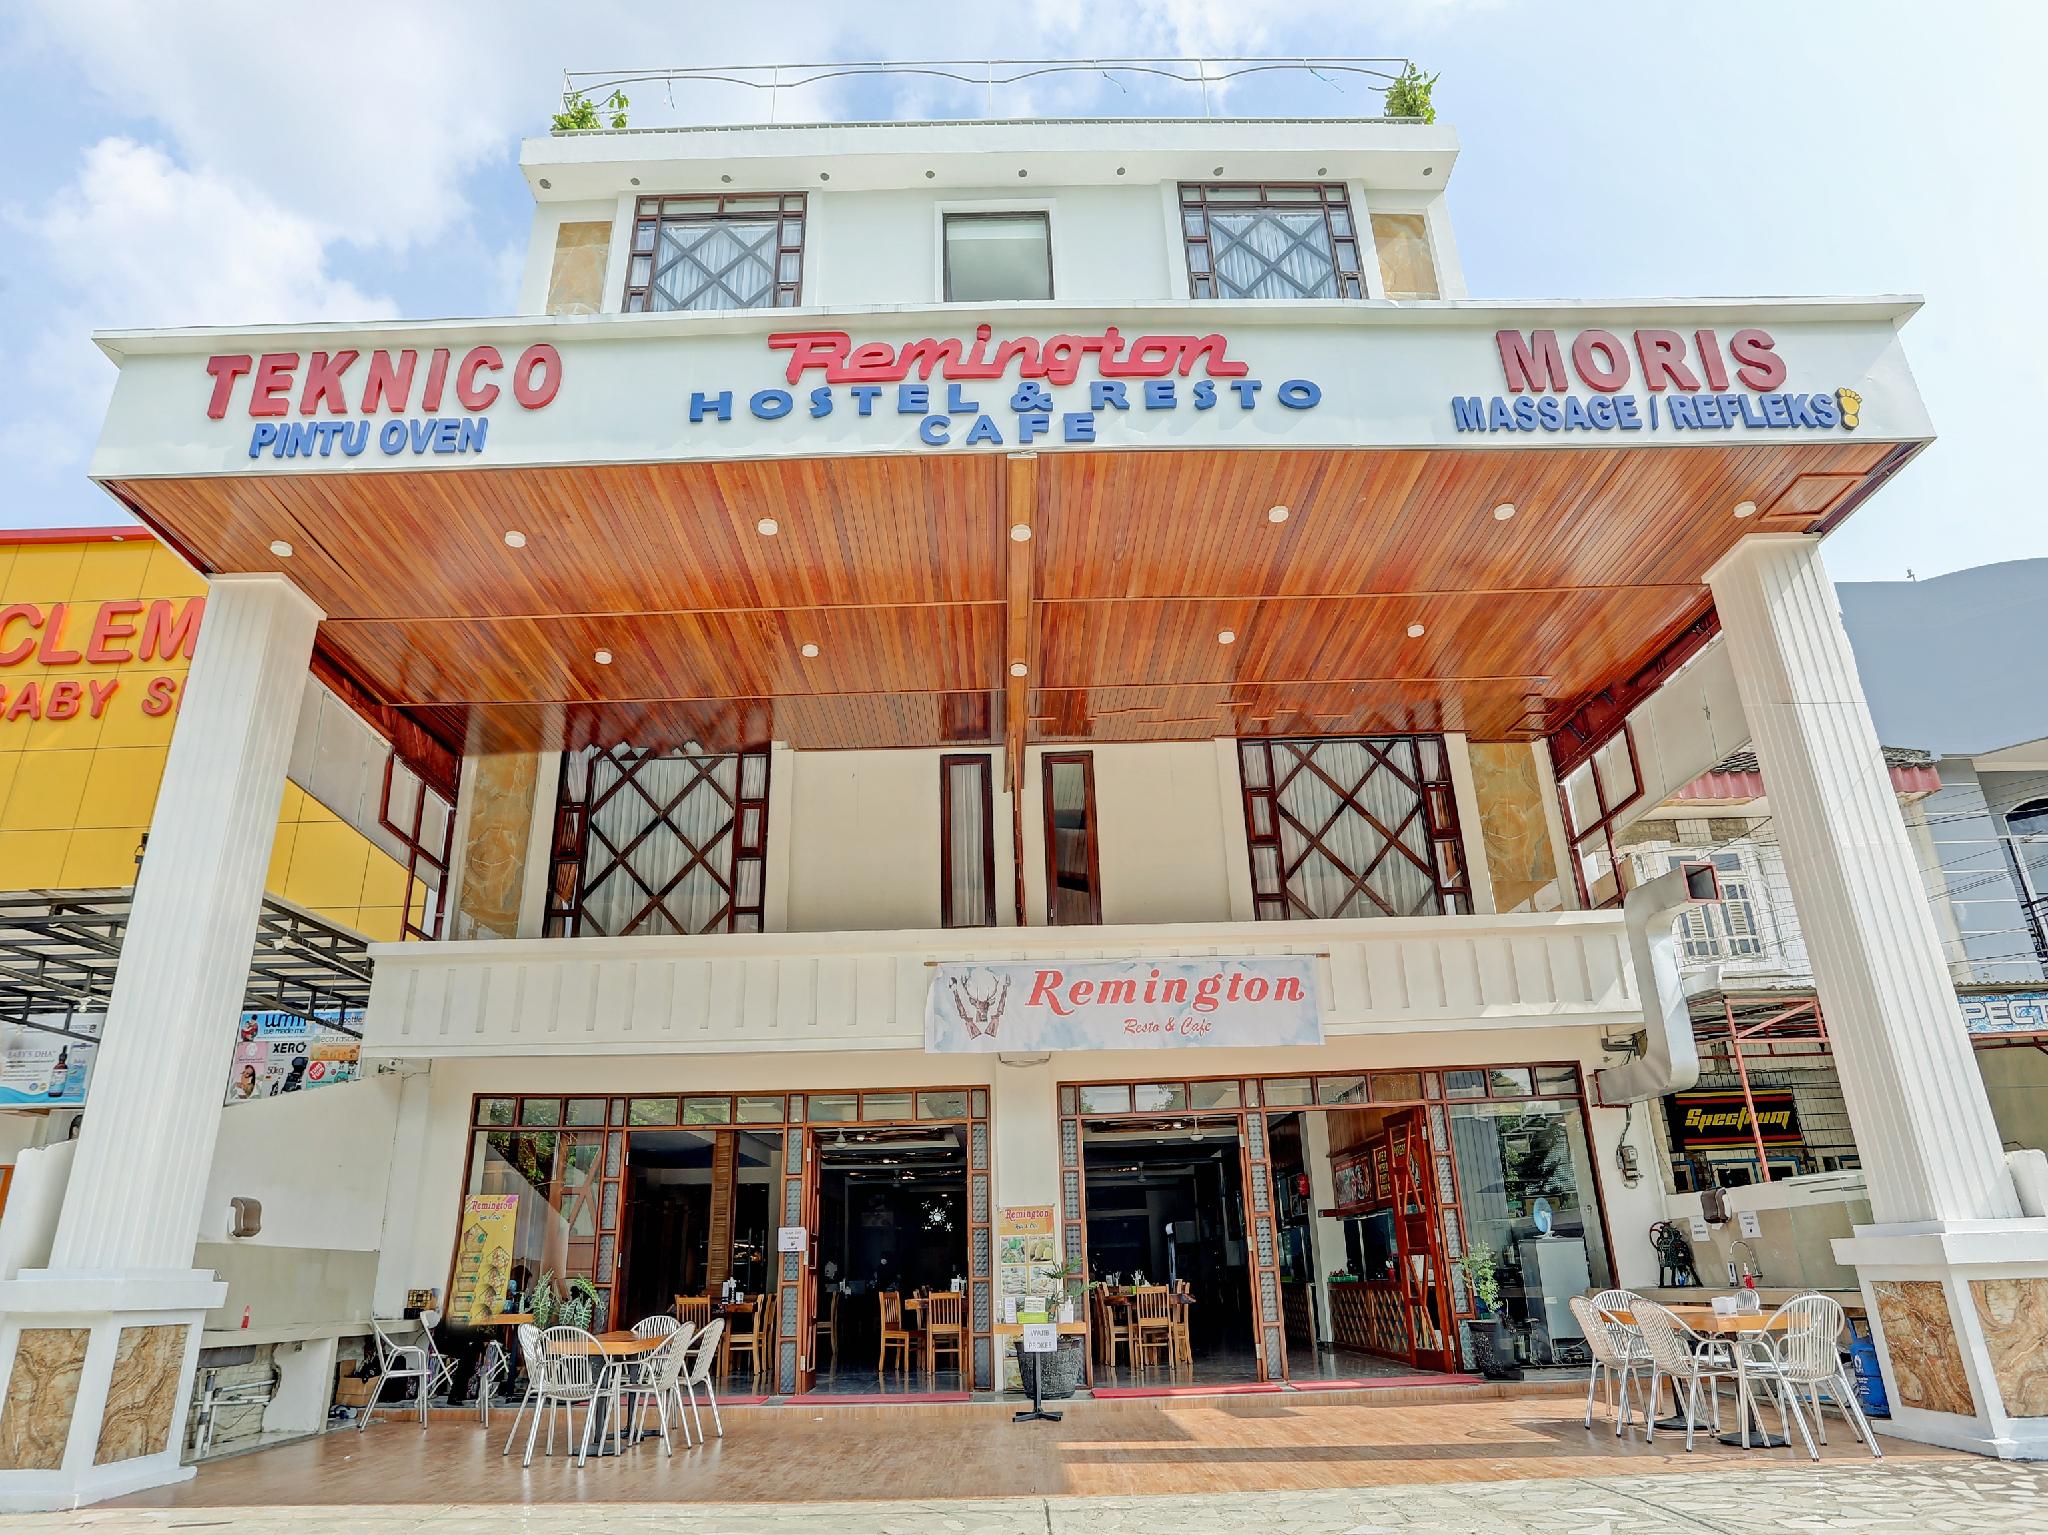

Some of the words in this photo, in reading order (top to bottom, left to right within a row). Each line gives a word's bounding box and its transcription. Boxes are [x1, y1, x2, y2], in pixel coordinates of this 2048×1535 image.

[768, 323, 1250, 385] Remington
[1495, 328, 1787, 393] MORIS
[207, 343, 563, 419] TEKNICO
[690, 384, 980, 422] HOSTEL
[1010, 381, 1054, 412] &
[1090, 379, 1322, 410] RESTO
[919, 412, 1096, 446] CAFE
[1452, 396, 1642, 432] MASSAGE
[1666, 393, 1841, 429] REFLEKS
[249, 419, 370, 458] PINTU
[379, 417, 489, 455] OVEN
[0, 679, 119, 722] ABY
[142, 676, 188, 717] S
[1025, 968, 1305, 1016] Remington
[1124, 1018, 1160, 1034] Resto
[1165, 1017, 1175, 1032] &
[1180, 1016, 1212, 1037] Cafe
[472, 1200, 513, 1212] Remington
[1005, 1209, 1049, 1221] Remington
